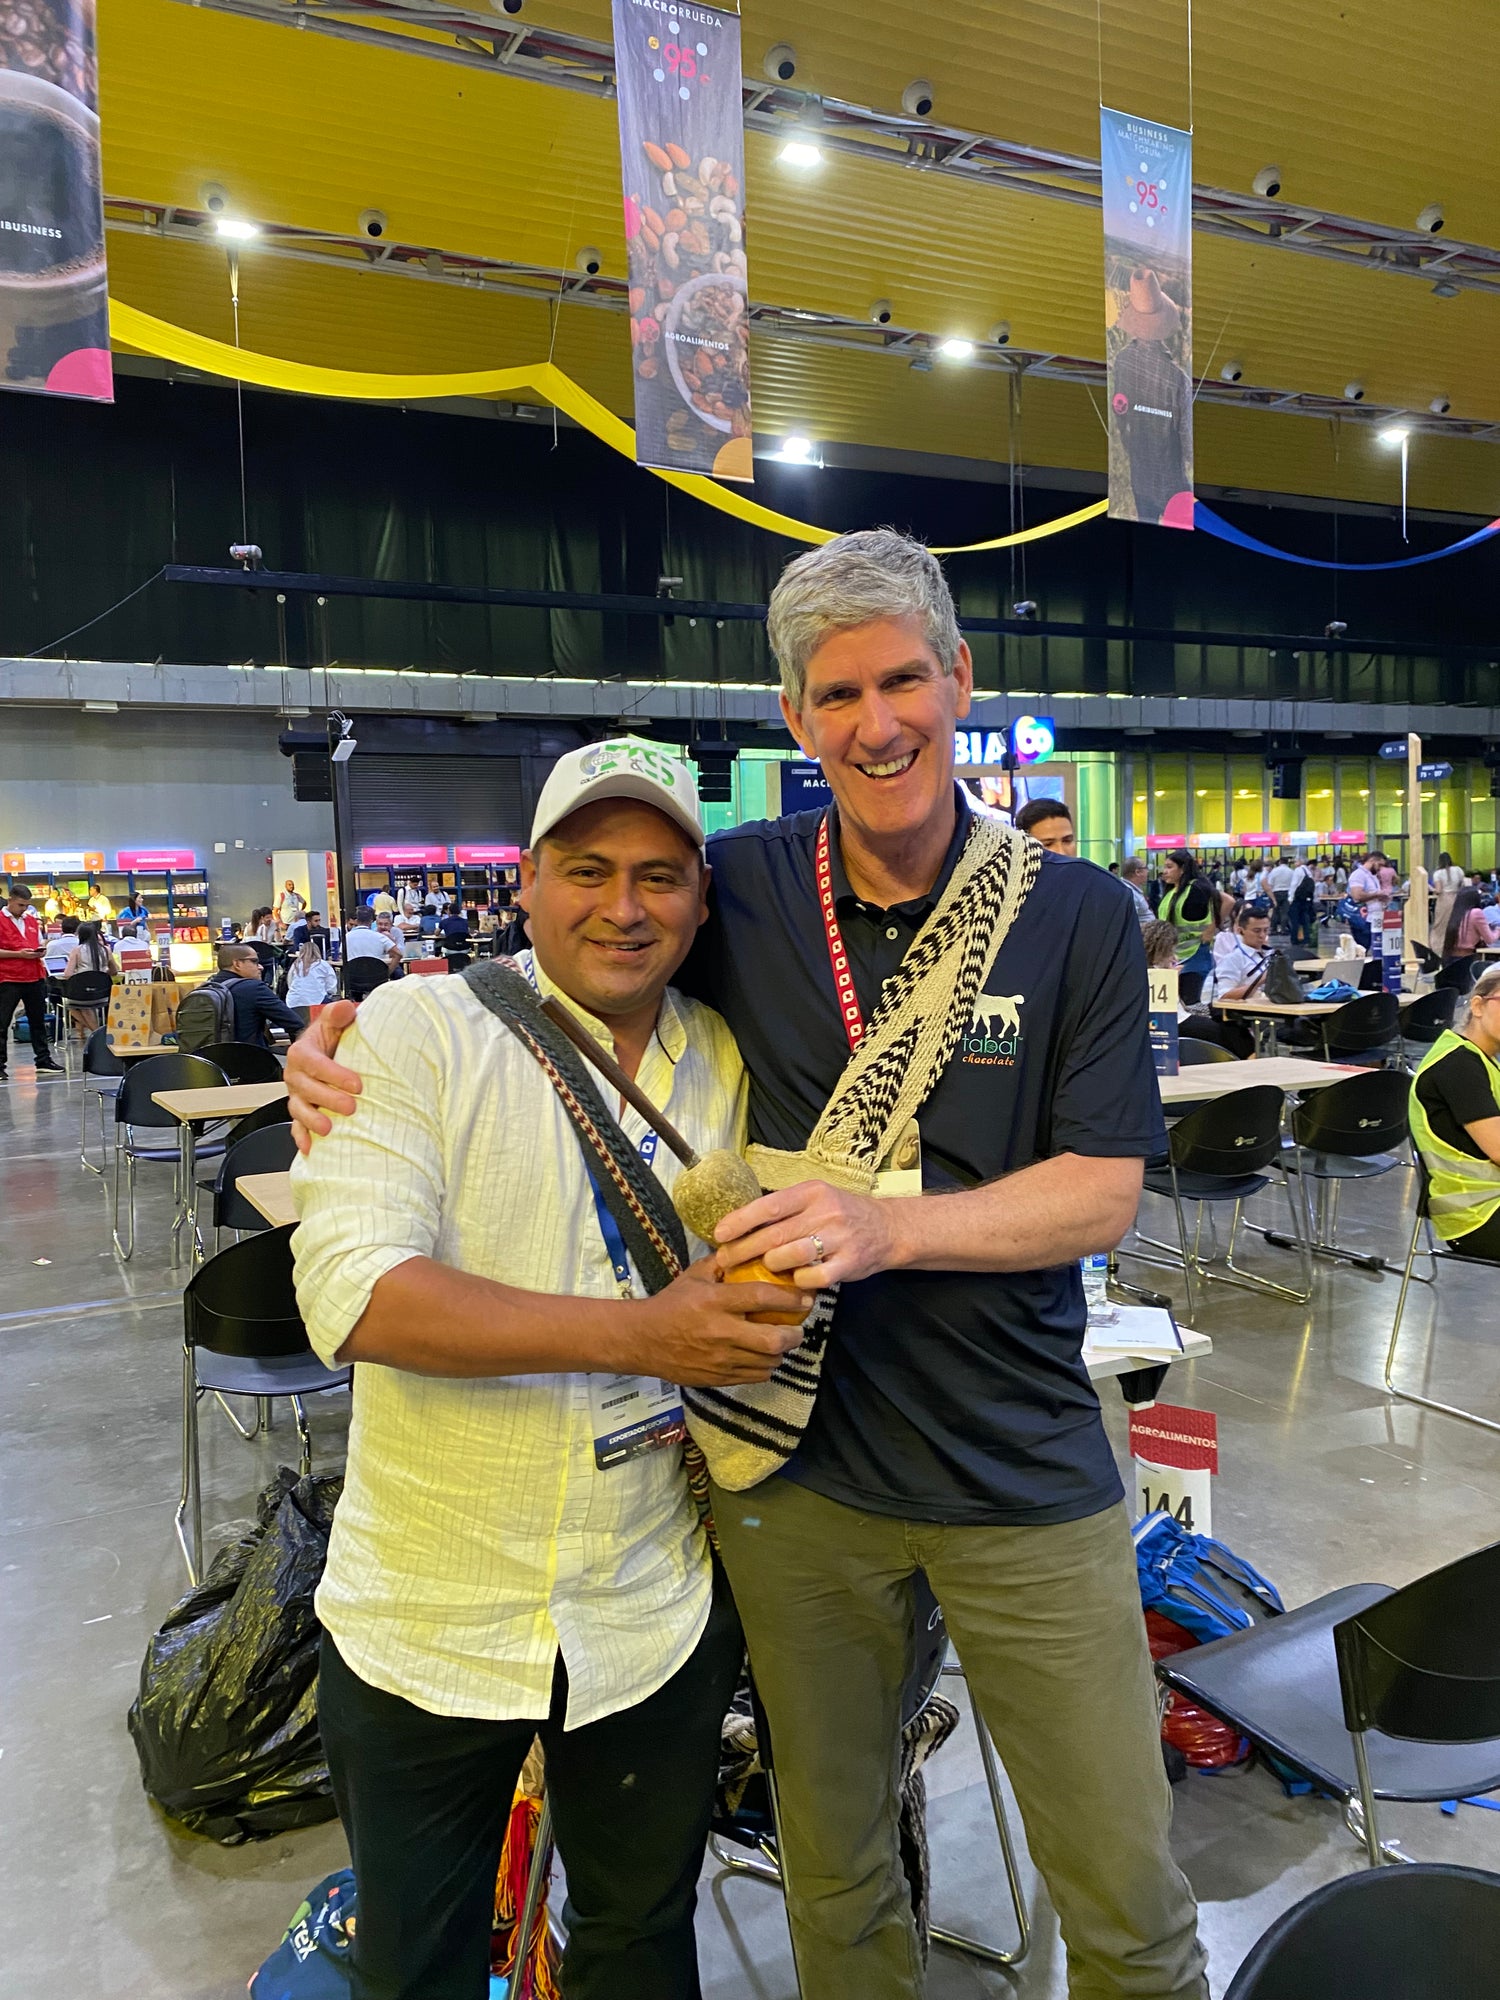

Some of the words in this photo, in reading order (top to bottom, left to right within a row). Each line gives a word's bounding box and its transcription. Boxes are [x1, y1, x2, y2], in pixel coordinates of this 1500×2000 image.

[663, 42, 698, 79] 95
[1117, 129, 1175, 153] MATCHMAKING
[1126, 122, 1168, 142] BUSINESS
[1134, 143, 1161, 158] FORUM
[1136, 180, 1159, 209] 95
[664, 331, 730, 351] AGROALIMENTOS
[961, 1033, 1017, 1056] tabal
[962, 1052, 1016, 1067] chocolate
[1130, 1423, 1218, 1450] AGROALIMENTOS
